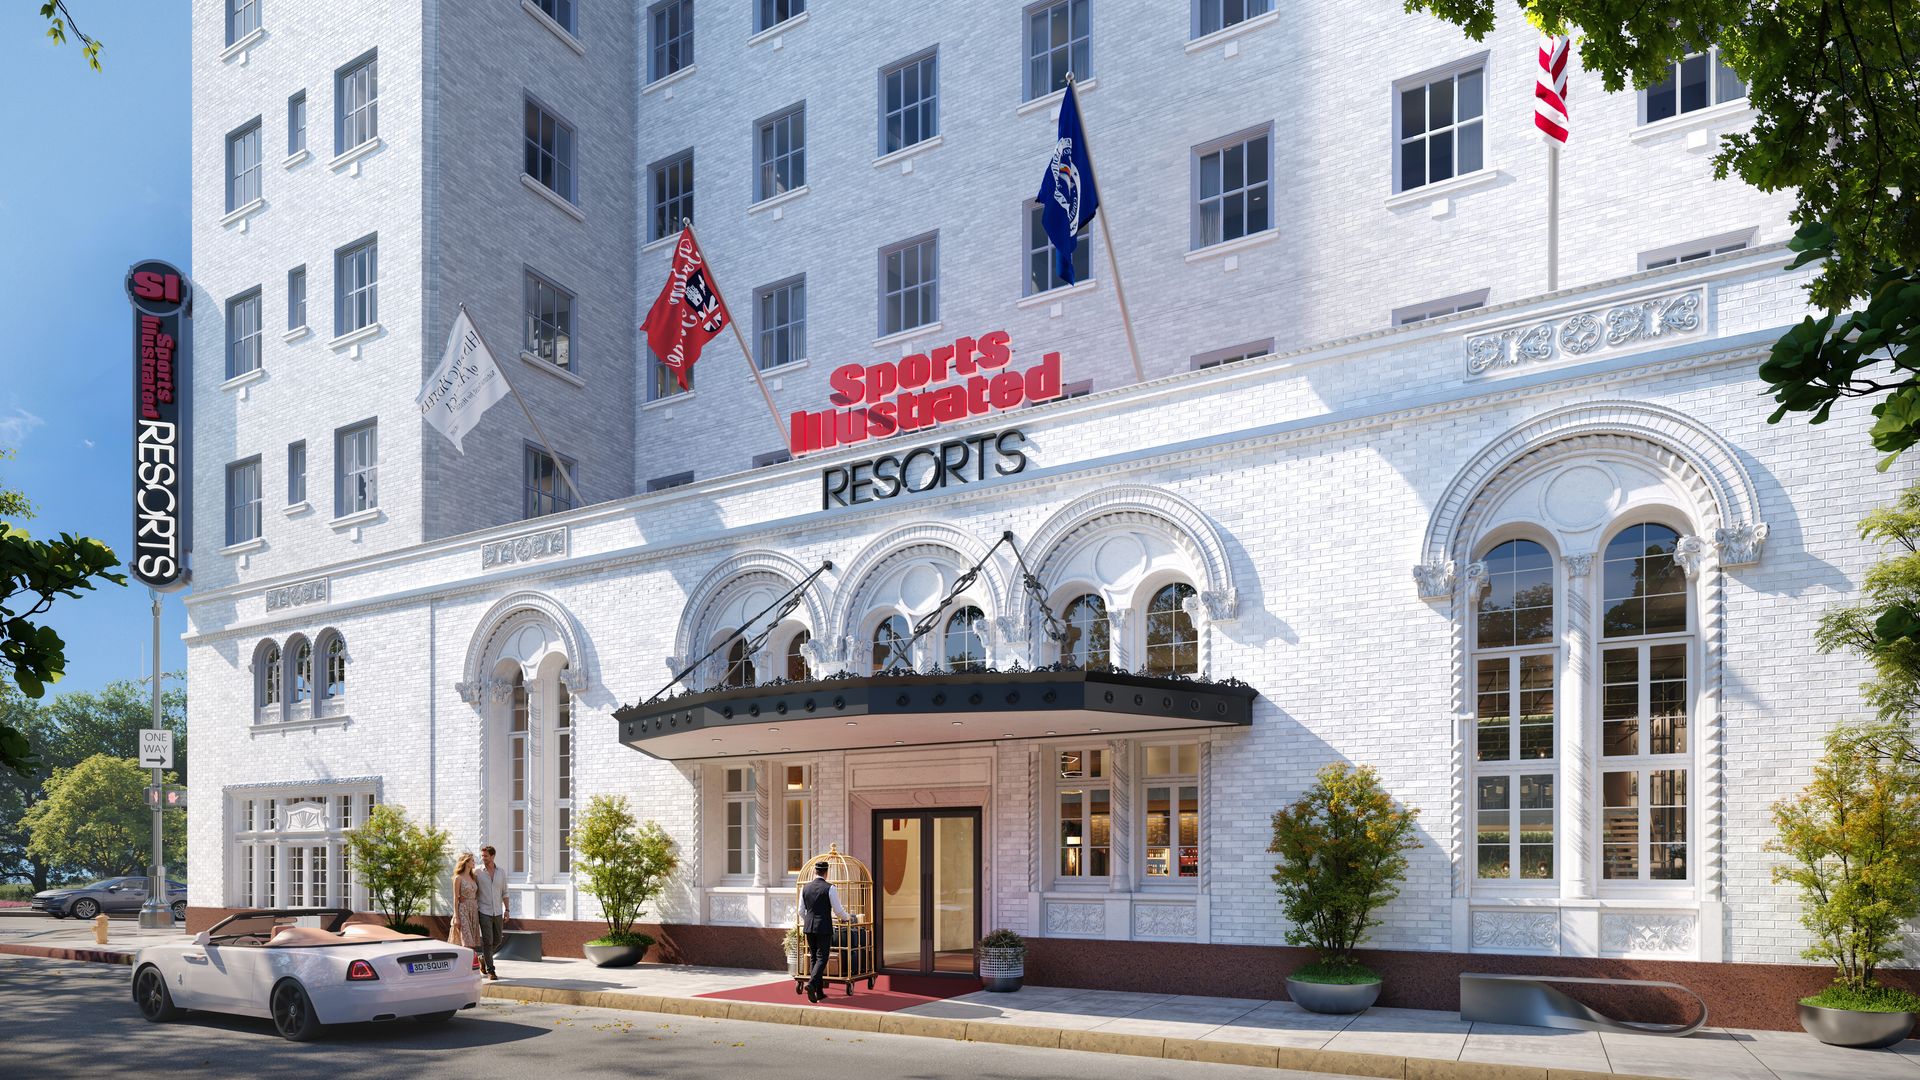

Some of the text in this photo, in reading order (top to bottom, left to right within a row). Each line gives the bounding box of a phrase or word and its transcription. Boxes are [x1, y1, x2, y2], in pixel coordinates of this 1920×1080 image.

[133, 271, 180, 304] SI
[141, 315, 161, 419] Illustrated
[156, 333, 174, 403] Sports
[790, 351, 1063, 457] Illustrated
[829, 330, 1013, 407] Sports
[137, 419, 176, 578] RESORTS
[822, 429, 1026, 510] RESORTS
[144, 732, 167, 742] ONE
[144, 744, 168, 753] WAY
